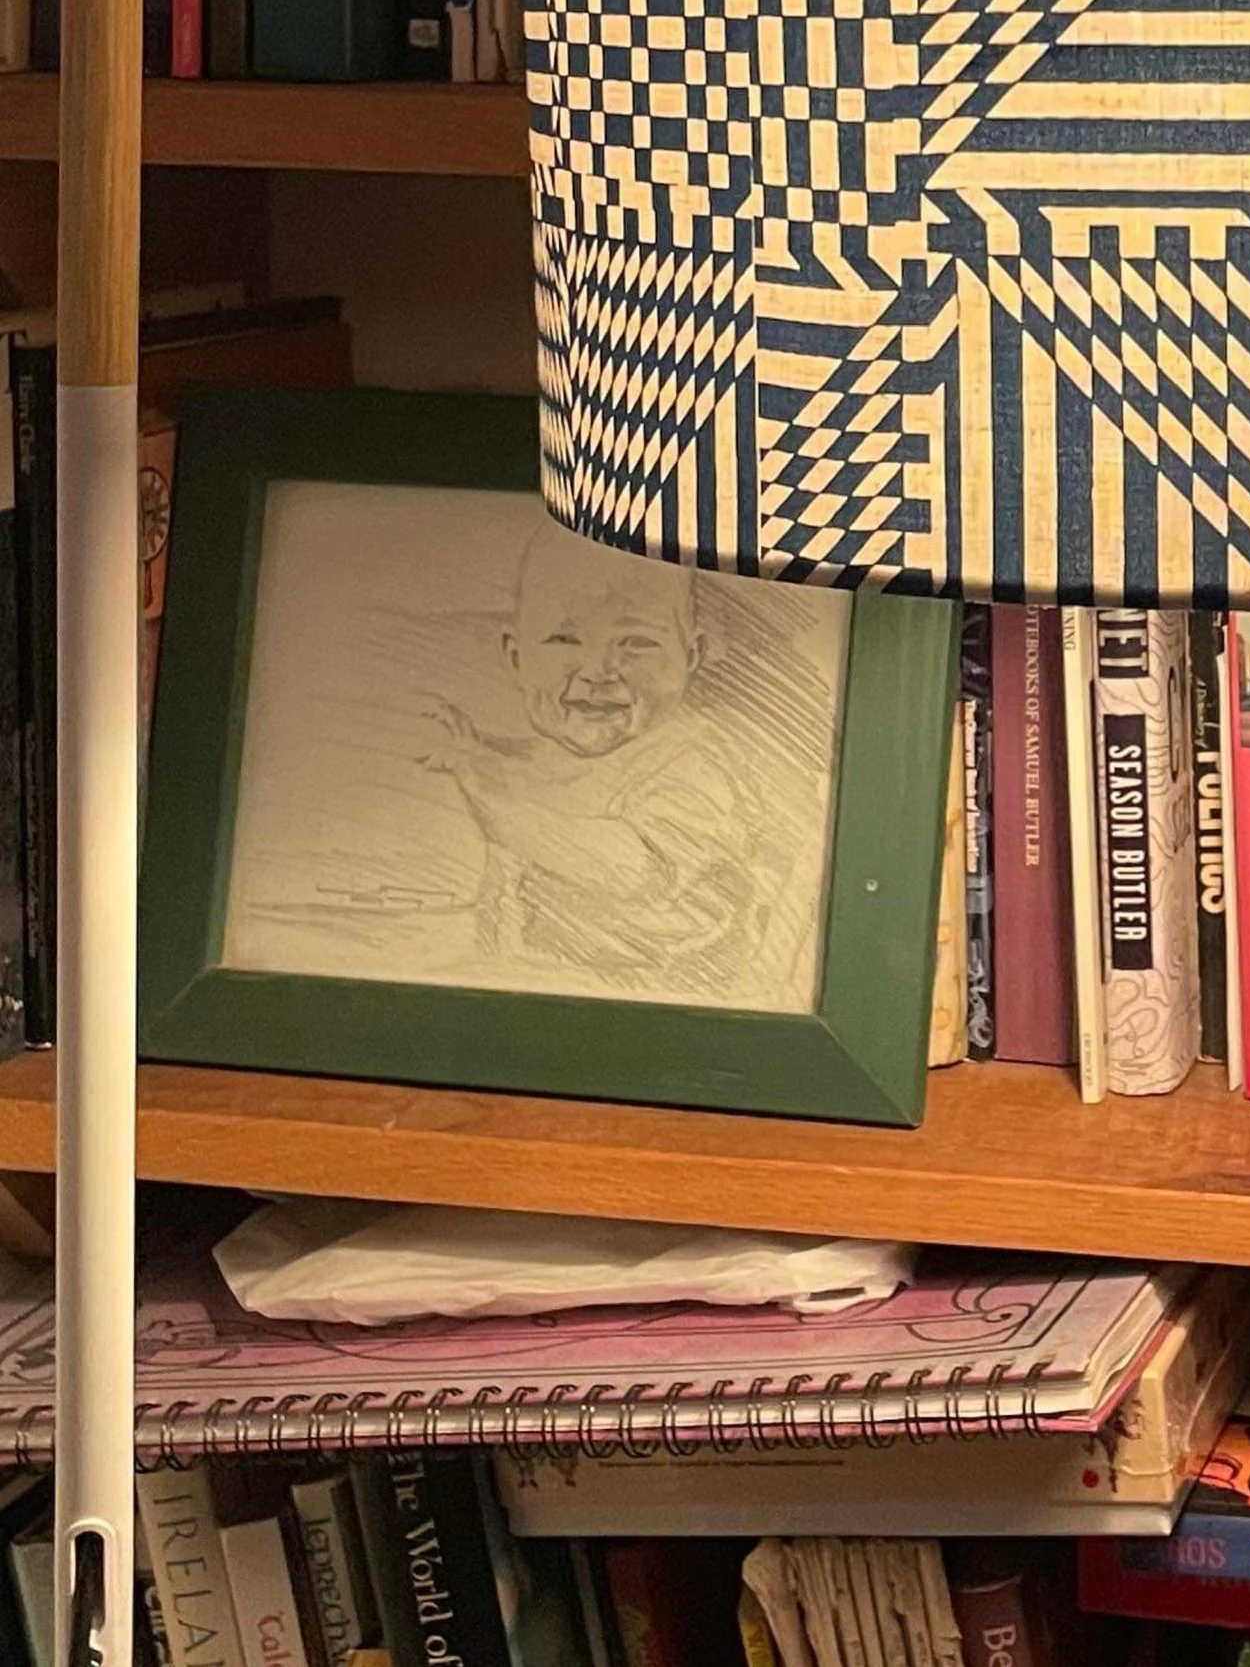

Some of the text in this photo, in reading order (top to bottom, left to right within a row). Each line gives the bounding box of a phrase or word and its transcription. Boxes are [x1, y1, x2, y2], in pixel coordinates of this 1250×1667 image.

[1025, 697, 1041, 866] OF SAMUEL BUTLER
[1109, 745, 1147, 941] SEASON BUTLER
[1195, 751, 1224, 914] POLITICS
[403, 1518, 465, 1667] World of
